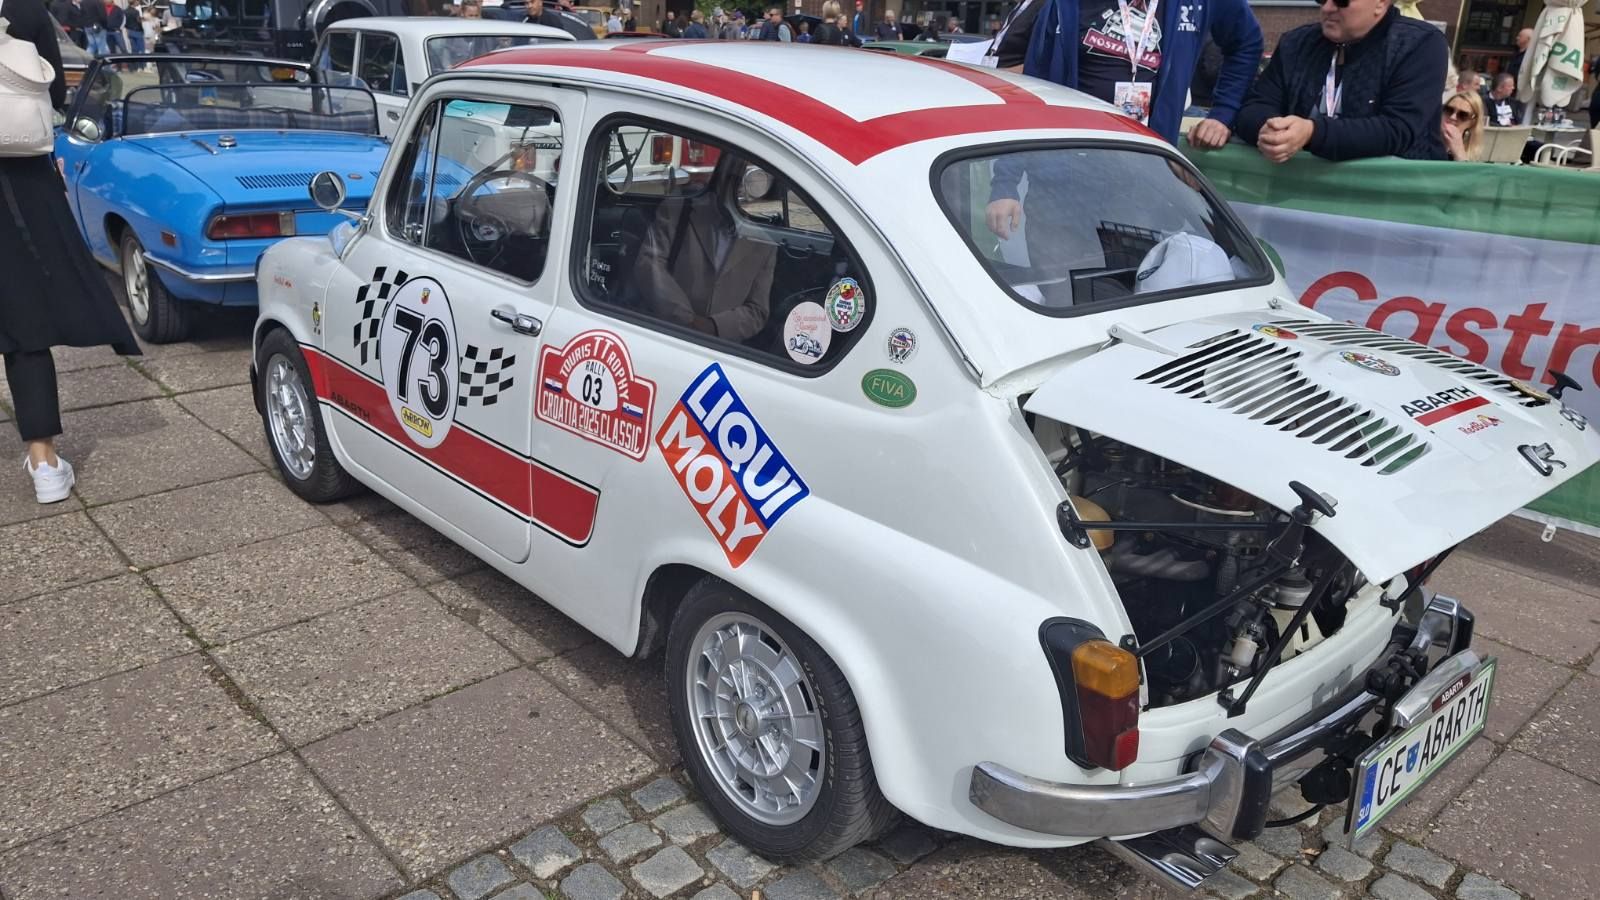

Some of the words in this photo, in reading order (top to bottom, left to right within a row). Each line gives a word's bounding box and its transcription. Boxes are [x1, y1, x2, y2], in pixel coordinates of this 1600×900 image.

[1089, 35, 1158, 64] NOSTAJA
[1299, 271, 1600, 386] Castr
[393, 304, 450, 421] 73
[585, 360, 606, 376] RALLY
[582, 374, 603, 406] 03
[871, 377, 905, 399] FIVA
[1400, 385, 1478, 417] ABARTH
[331, 391, 370, 423] ABARTH
[402, 410, 431, 431] ARROW
[542, 390, 578, 428] CROATIA
[578, 405, 601, 434] 2025
[600, 413, 642, 453] CLASSIC
[687, 370, 802, 520] LIQUI
[661, 410, 764, 552] MOLY
[803, 661, 829, 719] ULTRA
[1441, 679, 1464, 705] ABARTH
[1377, 745, 1407, 806] CE
[1418, 677, 1488, 773] ABARTH
[1358, 802, 1370, 823] SLO
